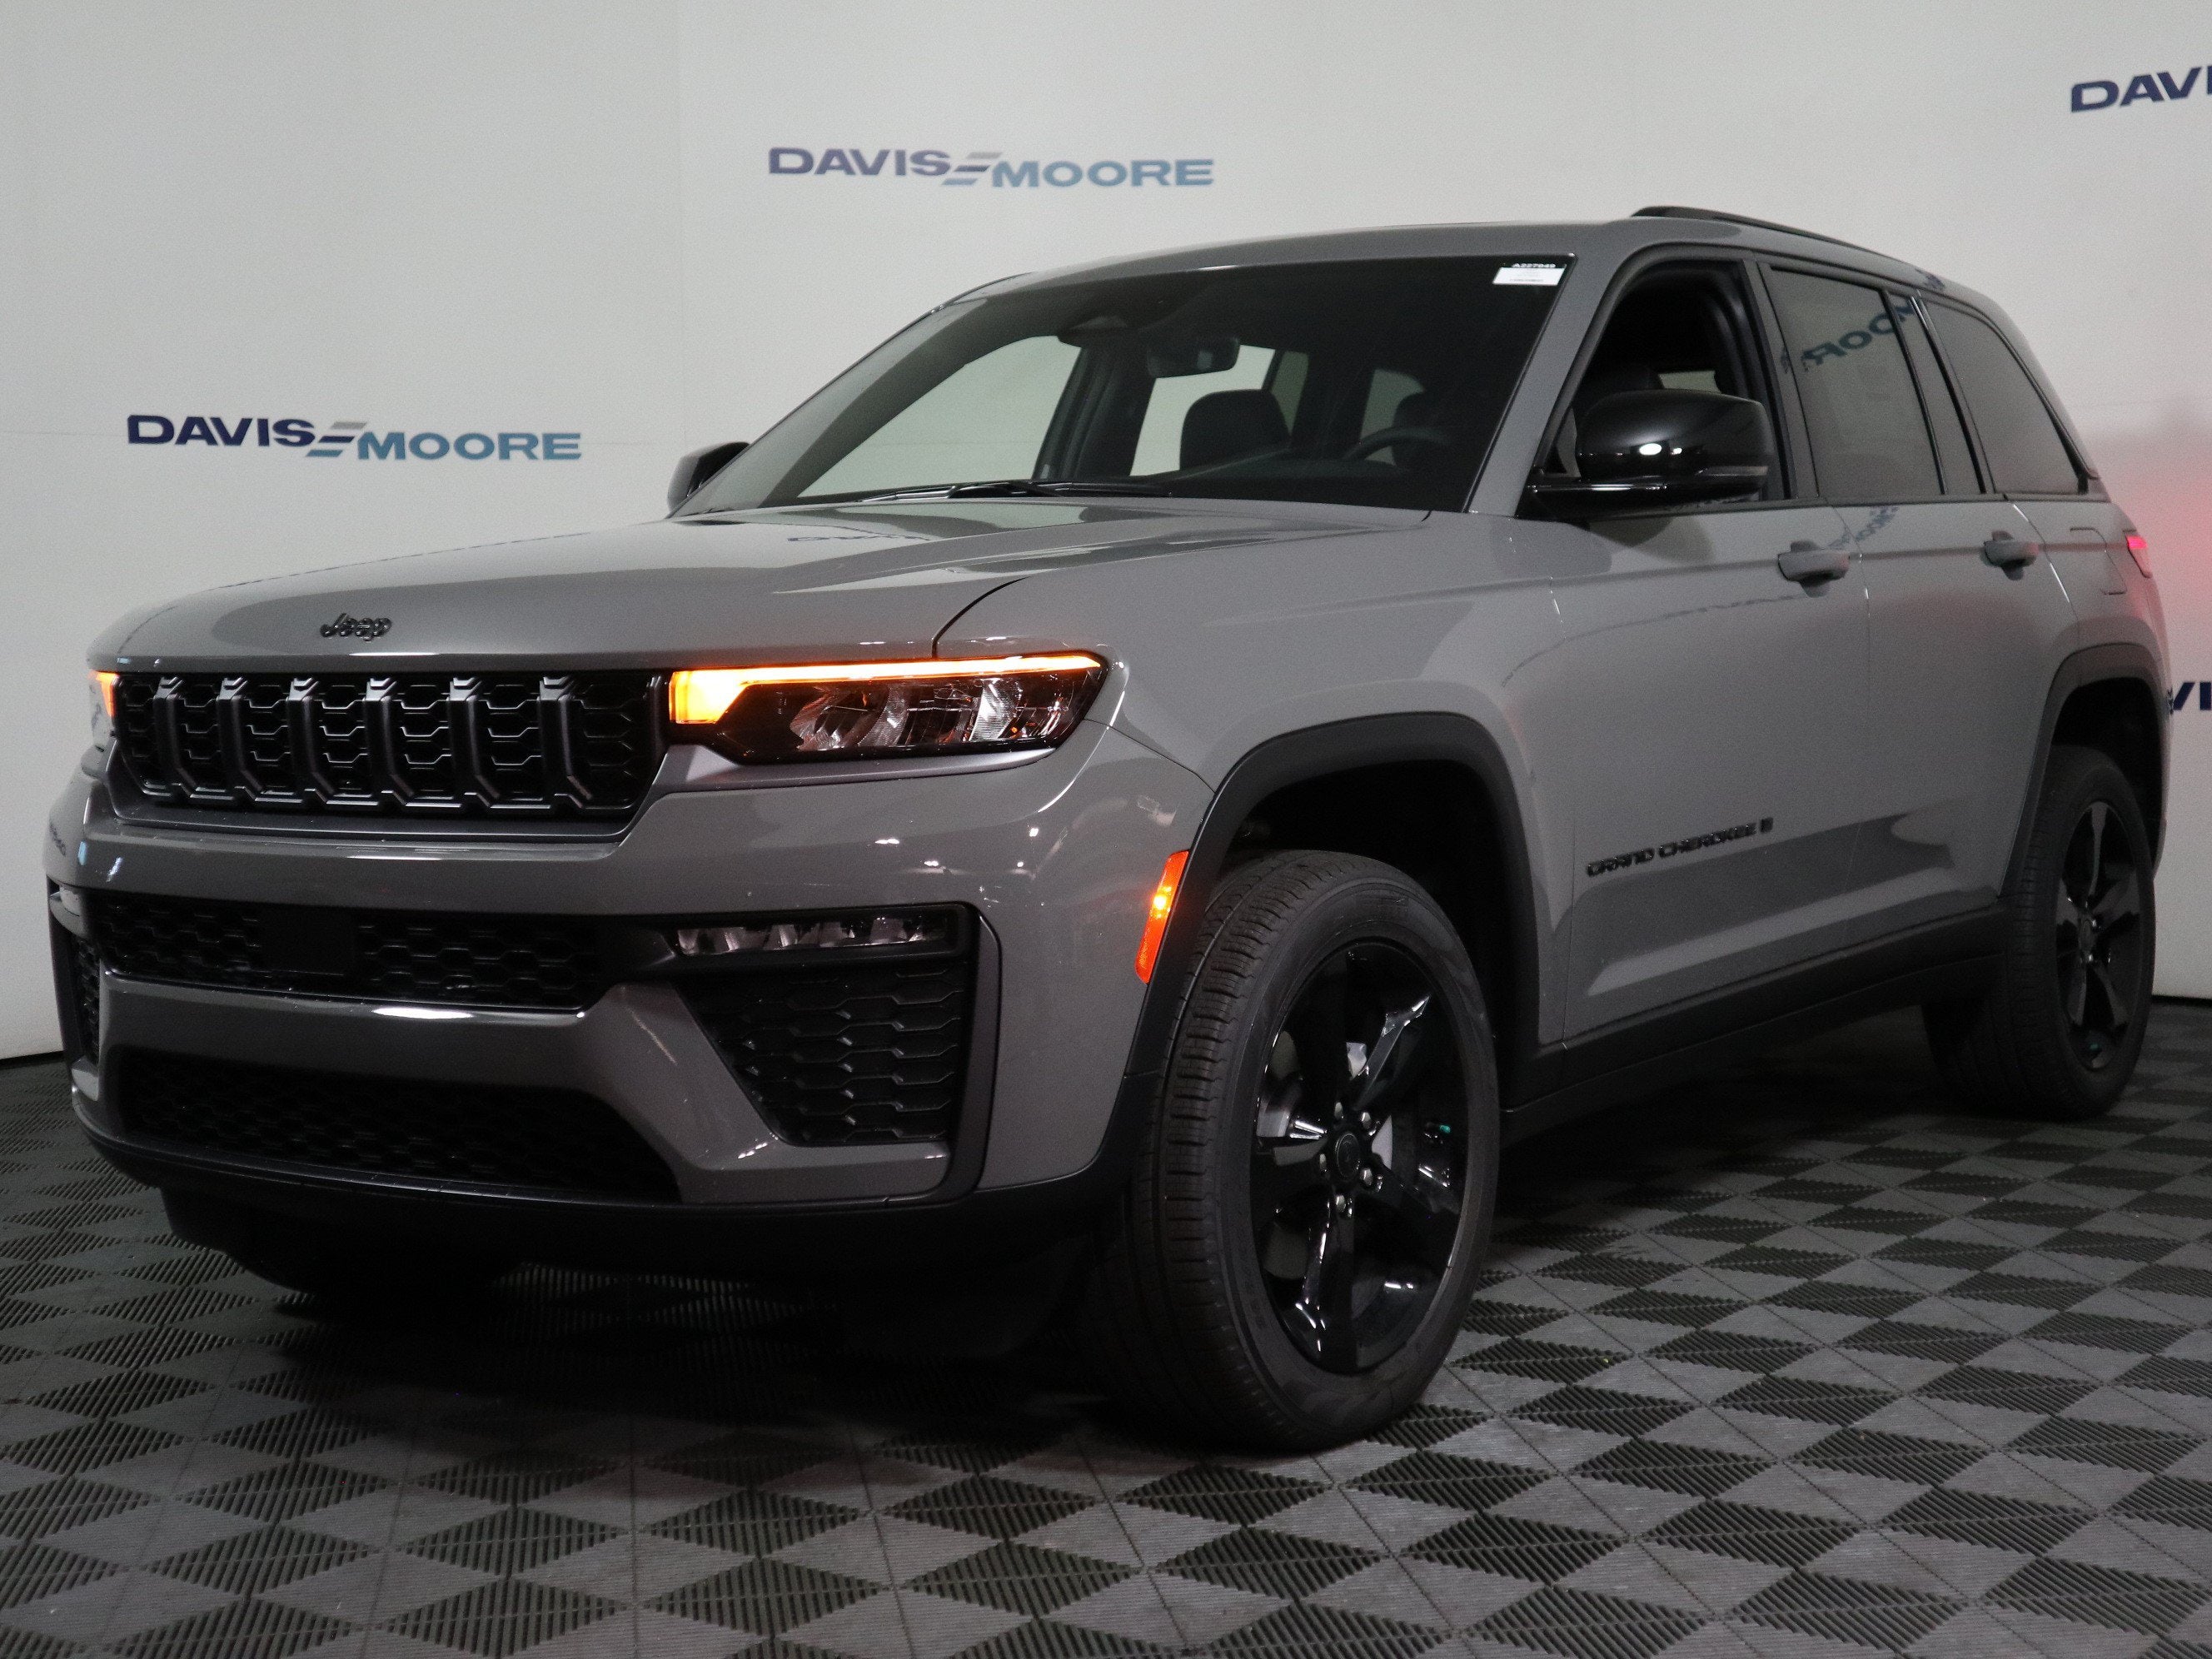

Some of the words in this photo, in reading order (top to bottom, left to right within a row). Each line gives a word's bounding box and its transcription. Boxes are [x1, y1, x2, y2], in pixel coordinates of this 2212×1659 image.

[768, 147, 953, 177] DAVIS
[991, 158, 1215, 188] MOORE
[126, 413, 316, 448] DAVIS
[356, 431, 582, 461] MOORE
[320, 612, 392, 642] Jeep
[1587, 847, 1656, 878] GRAND
[1658, 822, 1757, 858] CHEROKEE
